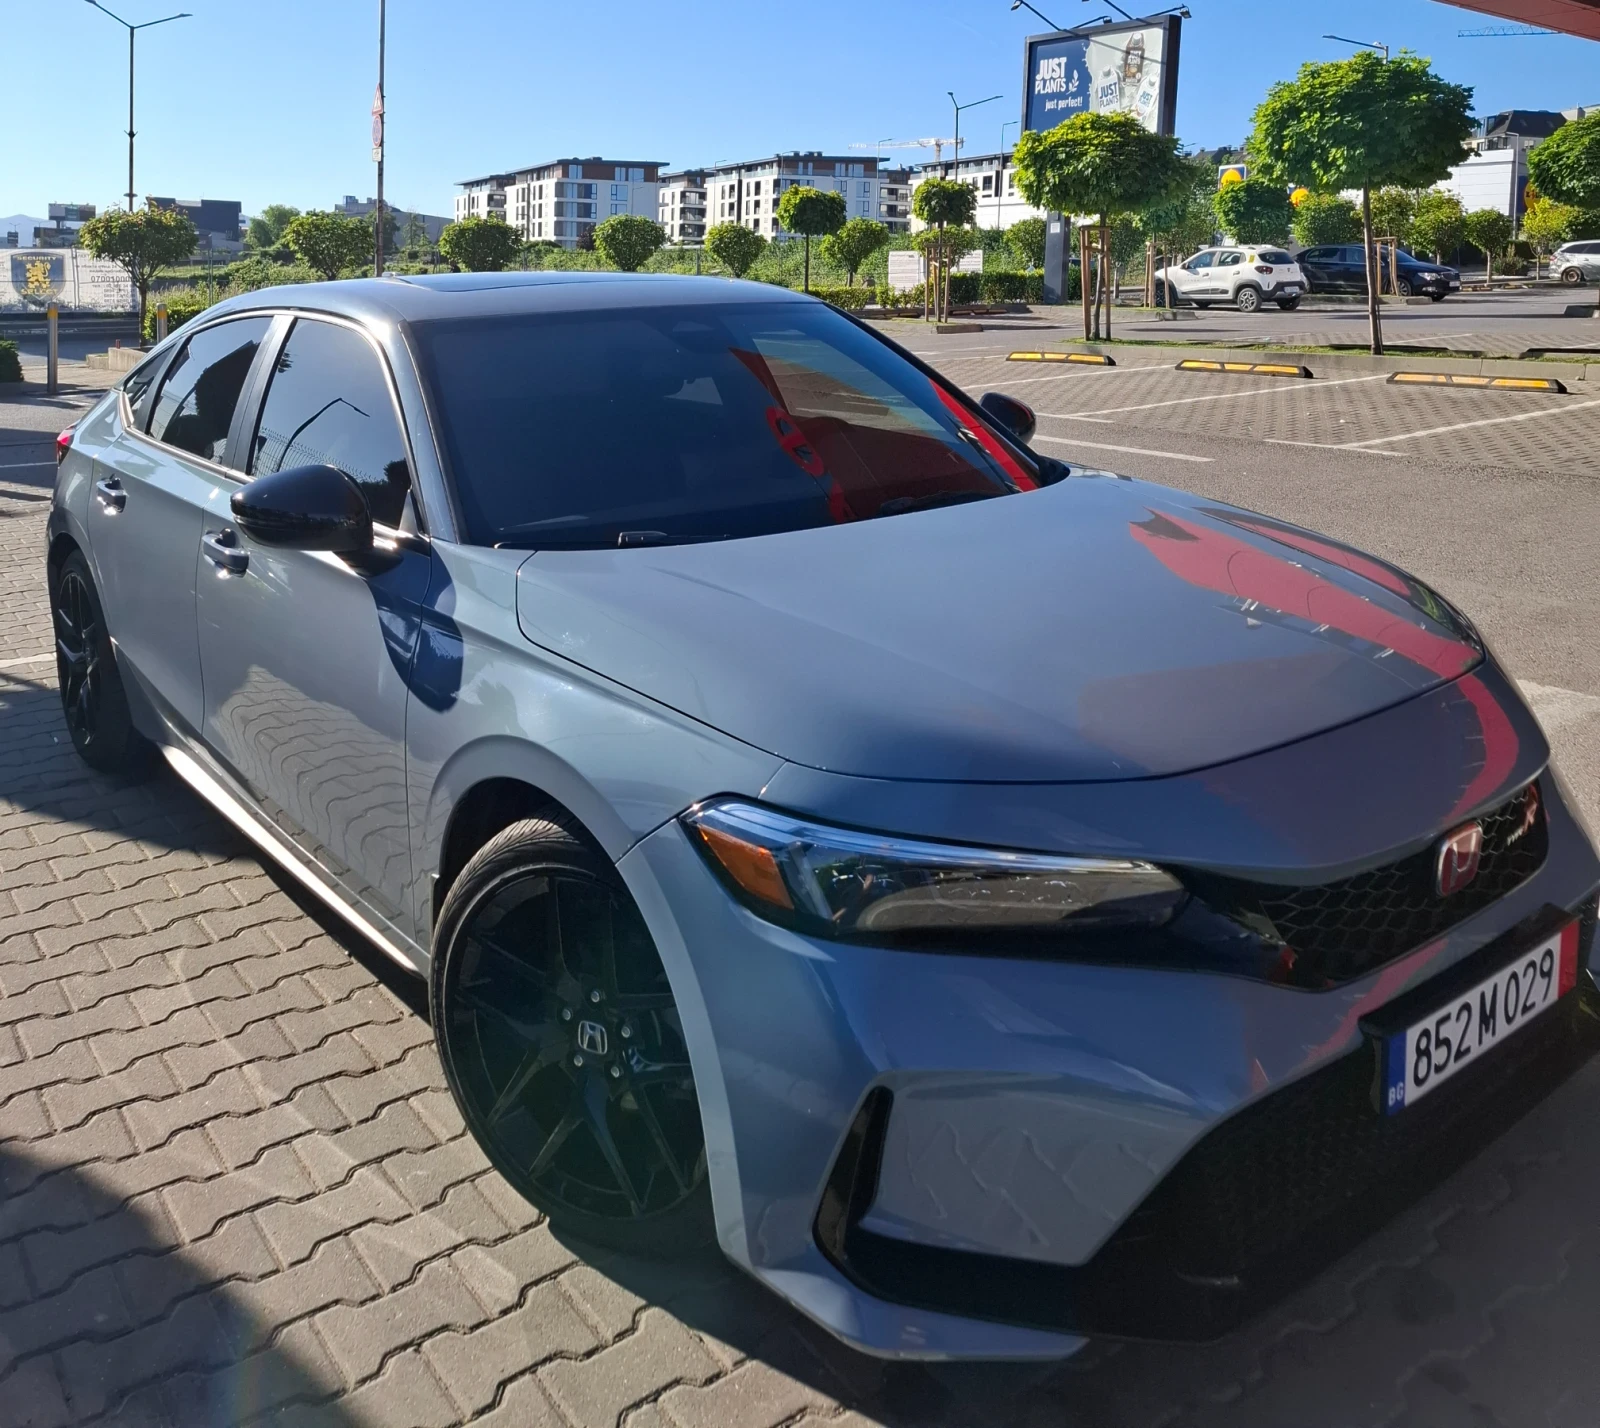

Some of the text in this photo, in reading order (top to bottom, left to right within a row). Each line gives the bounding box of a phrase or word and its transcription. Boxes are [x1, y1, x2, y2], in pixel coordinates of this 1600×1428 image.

[1035, 56, 1067, 80] JUST
[1034, 78, 1067, 95] PLANTS
[1099, 81, 1118, 100] JUST
[1044, 96, 1083, 112] just perfect!
[1099, 94, 1119, 108] PLANTS
[1388, 1081, 1405, 1108] BG
